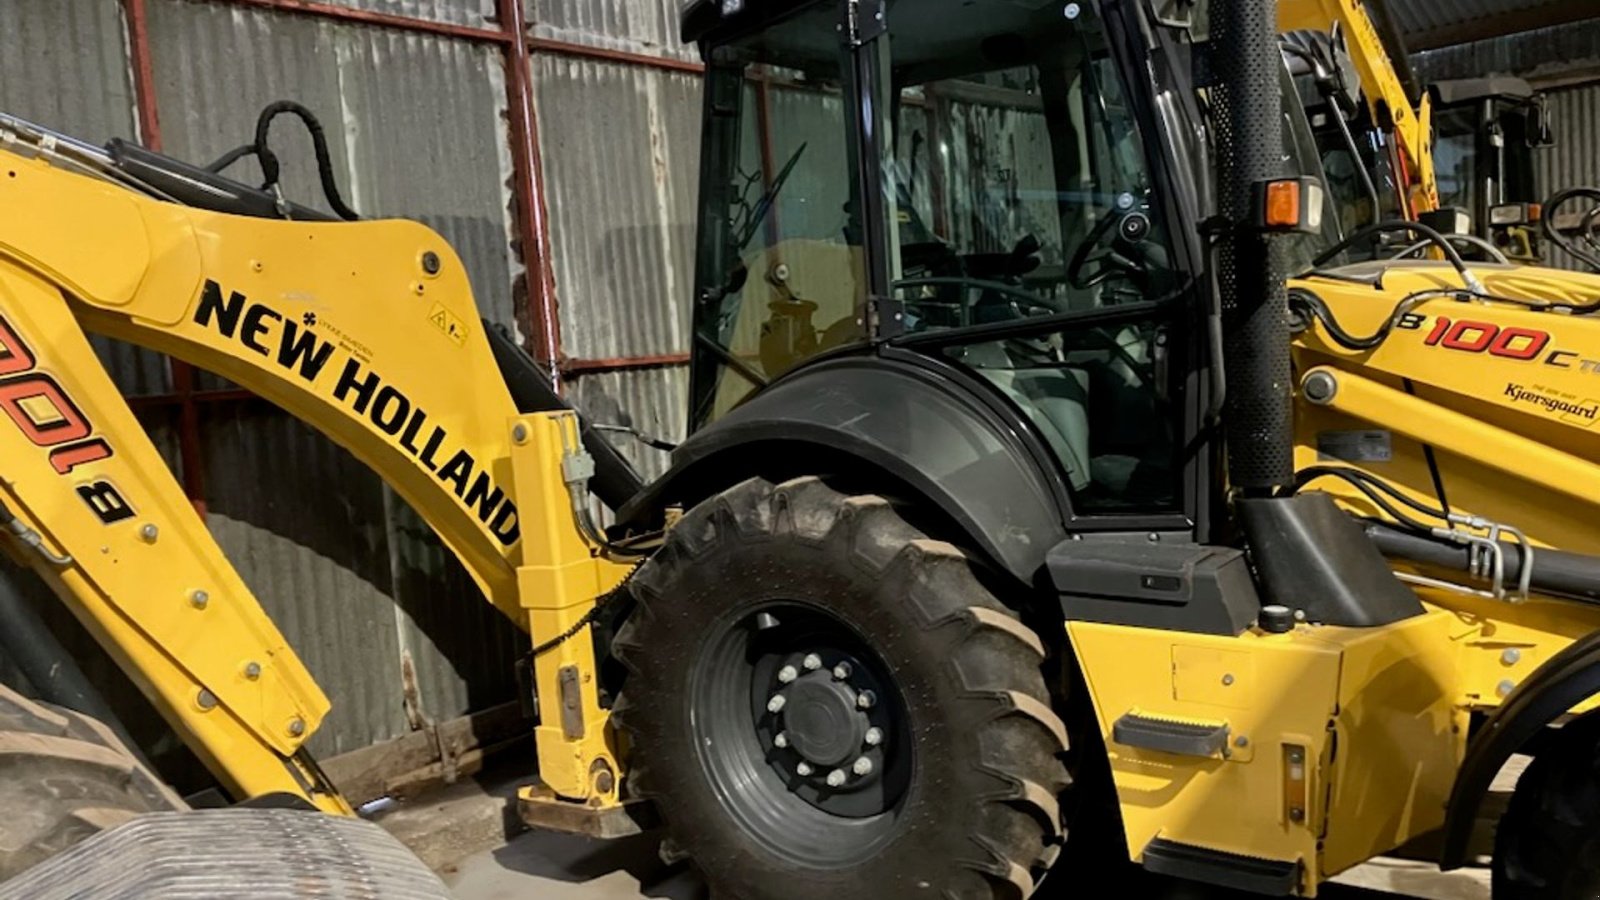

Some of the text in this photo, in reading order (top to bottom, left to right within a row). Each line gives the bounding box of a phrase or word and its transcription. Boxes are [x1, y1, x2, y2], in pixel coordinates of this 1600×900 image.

[1396, 313, 1427, 330] B
[1424, 316, 1550, 361] 100
[1544, 350, 1579, 368] C
[193, 278, 521, 546] NEW HOLLAND
[1504, 382, 1598, 419] Kjærsgaard
[75, 481, 137, 525] B
